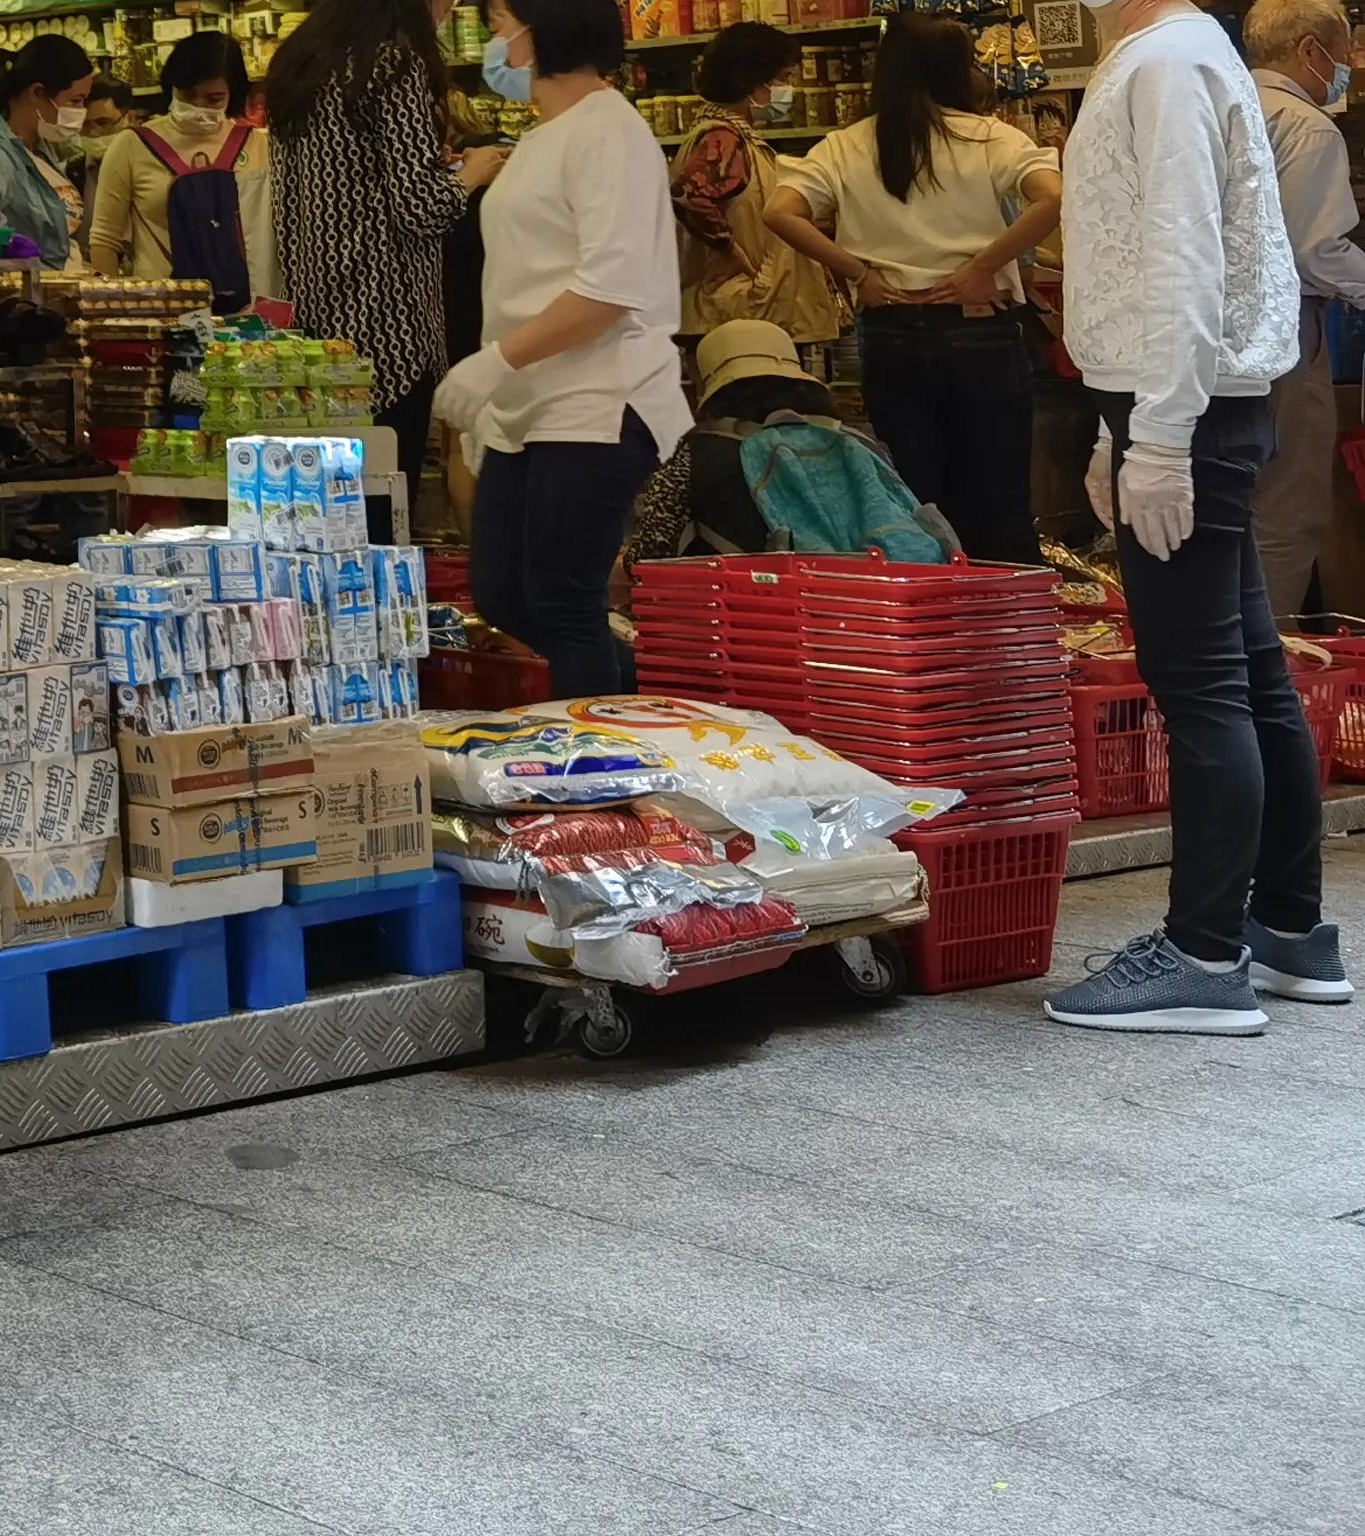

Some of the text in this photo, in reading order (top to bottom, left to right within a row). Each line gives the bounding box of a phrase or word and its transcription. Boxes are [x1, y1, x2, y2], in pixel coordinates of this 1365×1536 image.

[29, 591, 53, 665] vitasoy
[71, 586, 95, 660] vitasoy
[43, 680, 70, 754] vitasoy
[287, 726, 303, 745] M
[136, 745, 154, 764] M
[5, 775, 34, 849] vitasoy
[52, 768, 77, 844] vitasoy
[94, 762, 118, 837] vitasoy
[150, 818, 160, 836] S
[298, 801, 308, 819] S
